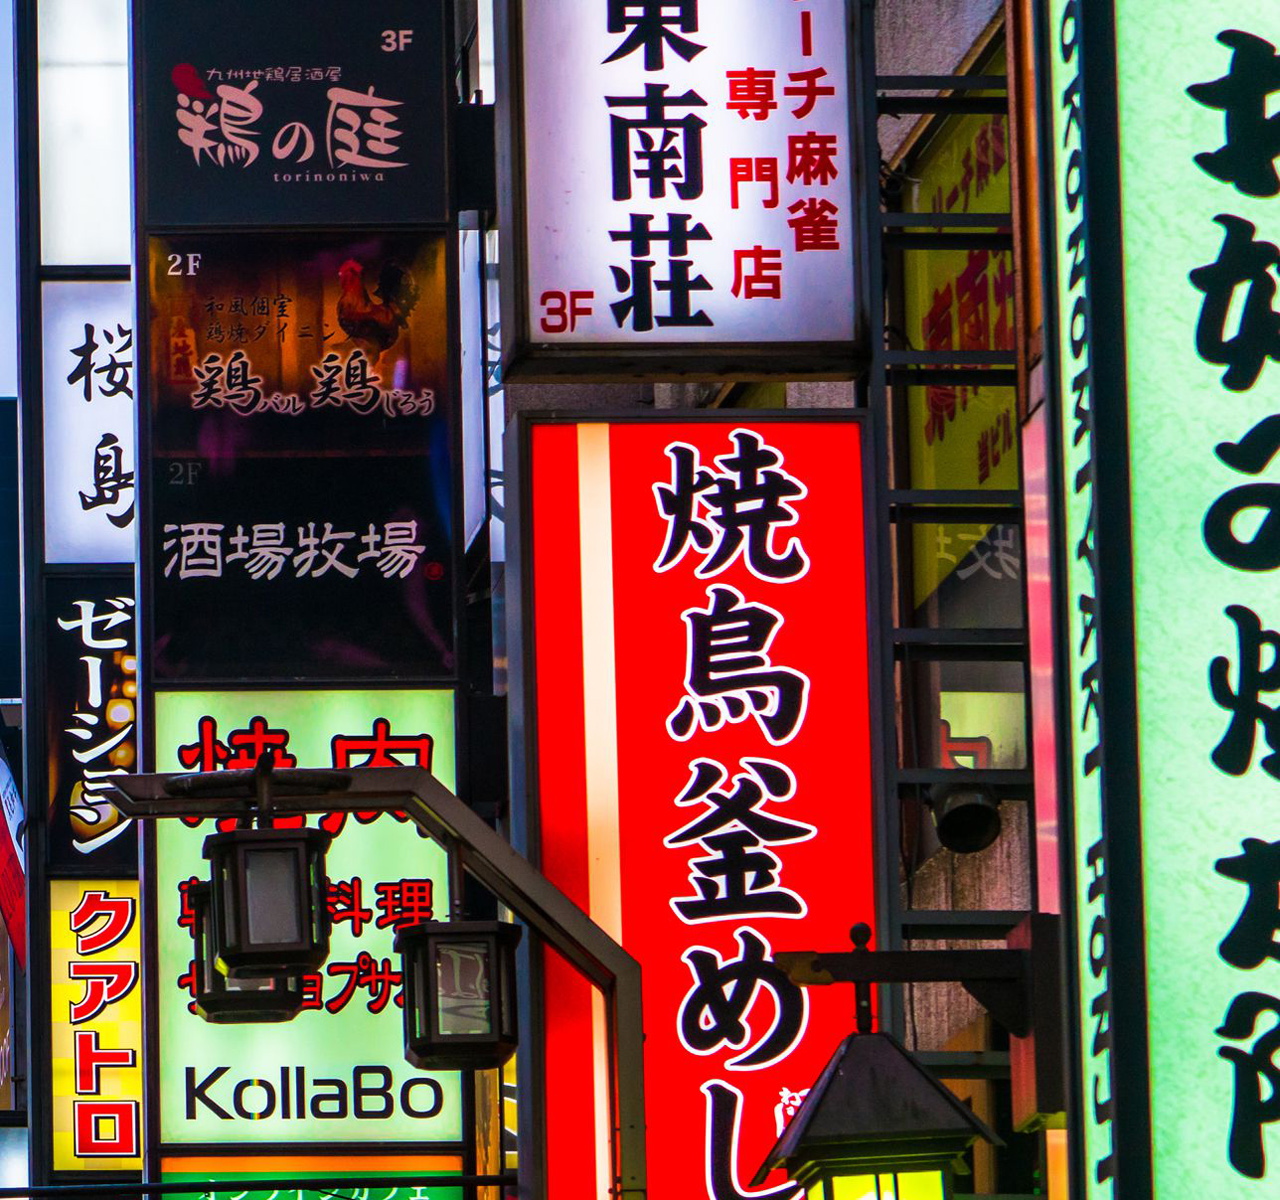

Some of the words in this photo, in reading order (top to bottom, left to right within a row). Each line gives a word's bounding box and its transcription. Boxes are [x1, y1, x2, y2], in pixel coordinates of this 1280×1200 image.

[380, 30, 415, 53] 3F
[206, 66, 343, 83] 九州地鶏居酒屋
[173, 80, 411, 170] 鶏の庭
[273, 171, 385, 182] torinoniwa
[601, 0, 715, 332] 東南荘
[726, 68, 782, 301] 専門店
[166, 253, 202, 277] 2F
[205, 293, 293, 319] 和風個室
[540, 290, 595, 333] 3F
[168, 461, 203, 487] 2F
[162, 520, 428, 581] 酒場牧場
[69, 890, 139, 1158] クアトロ
[184, 1065, 445, 1121] KollaBo
